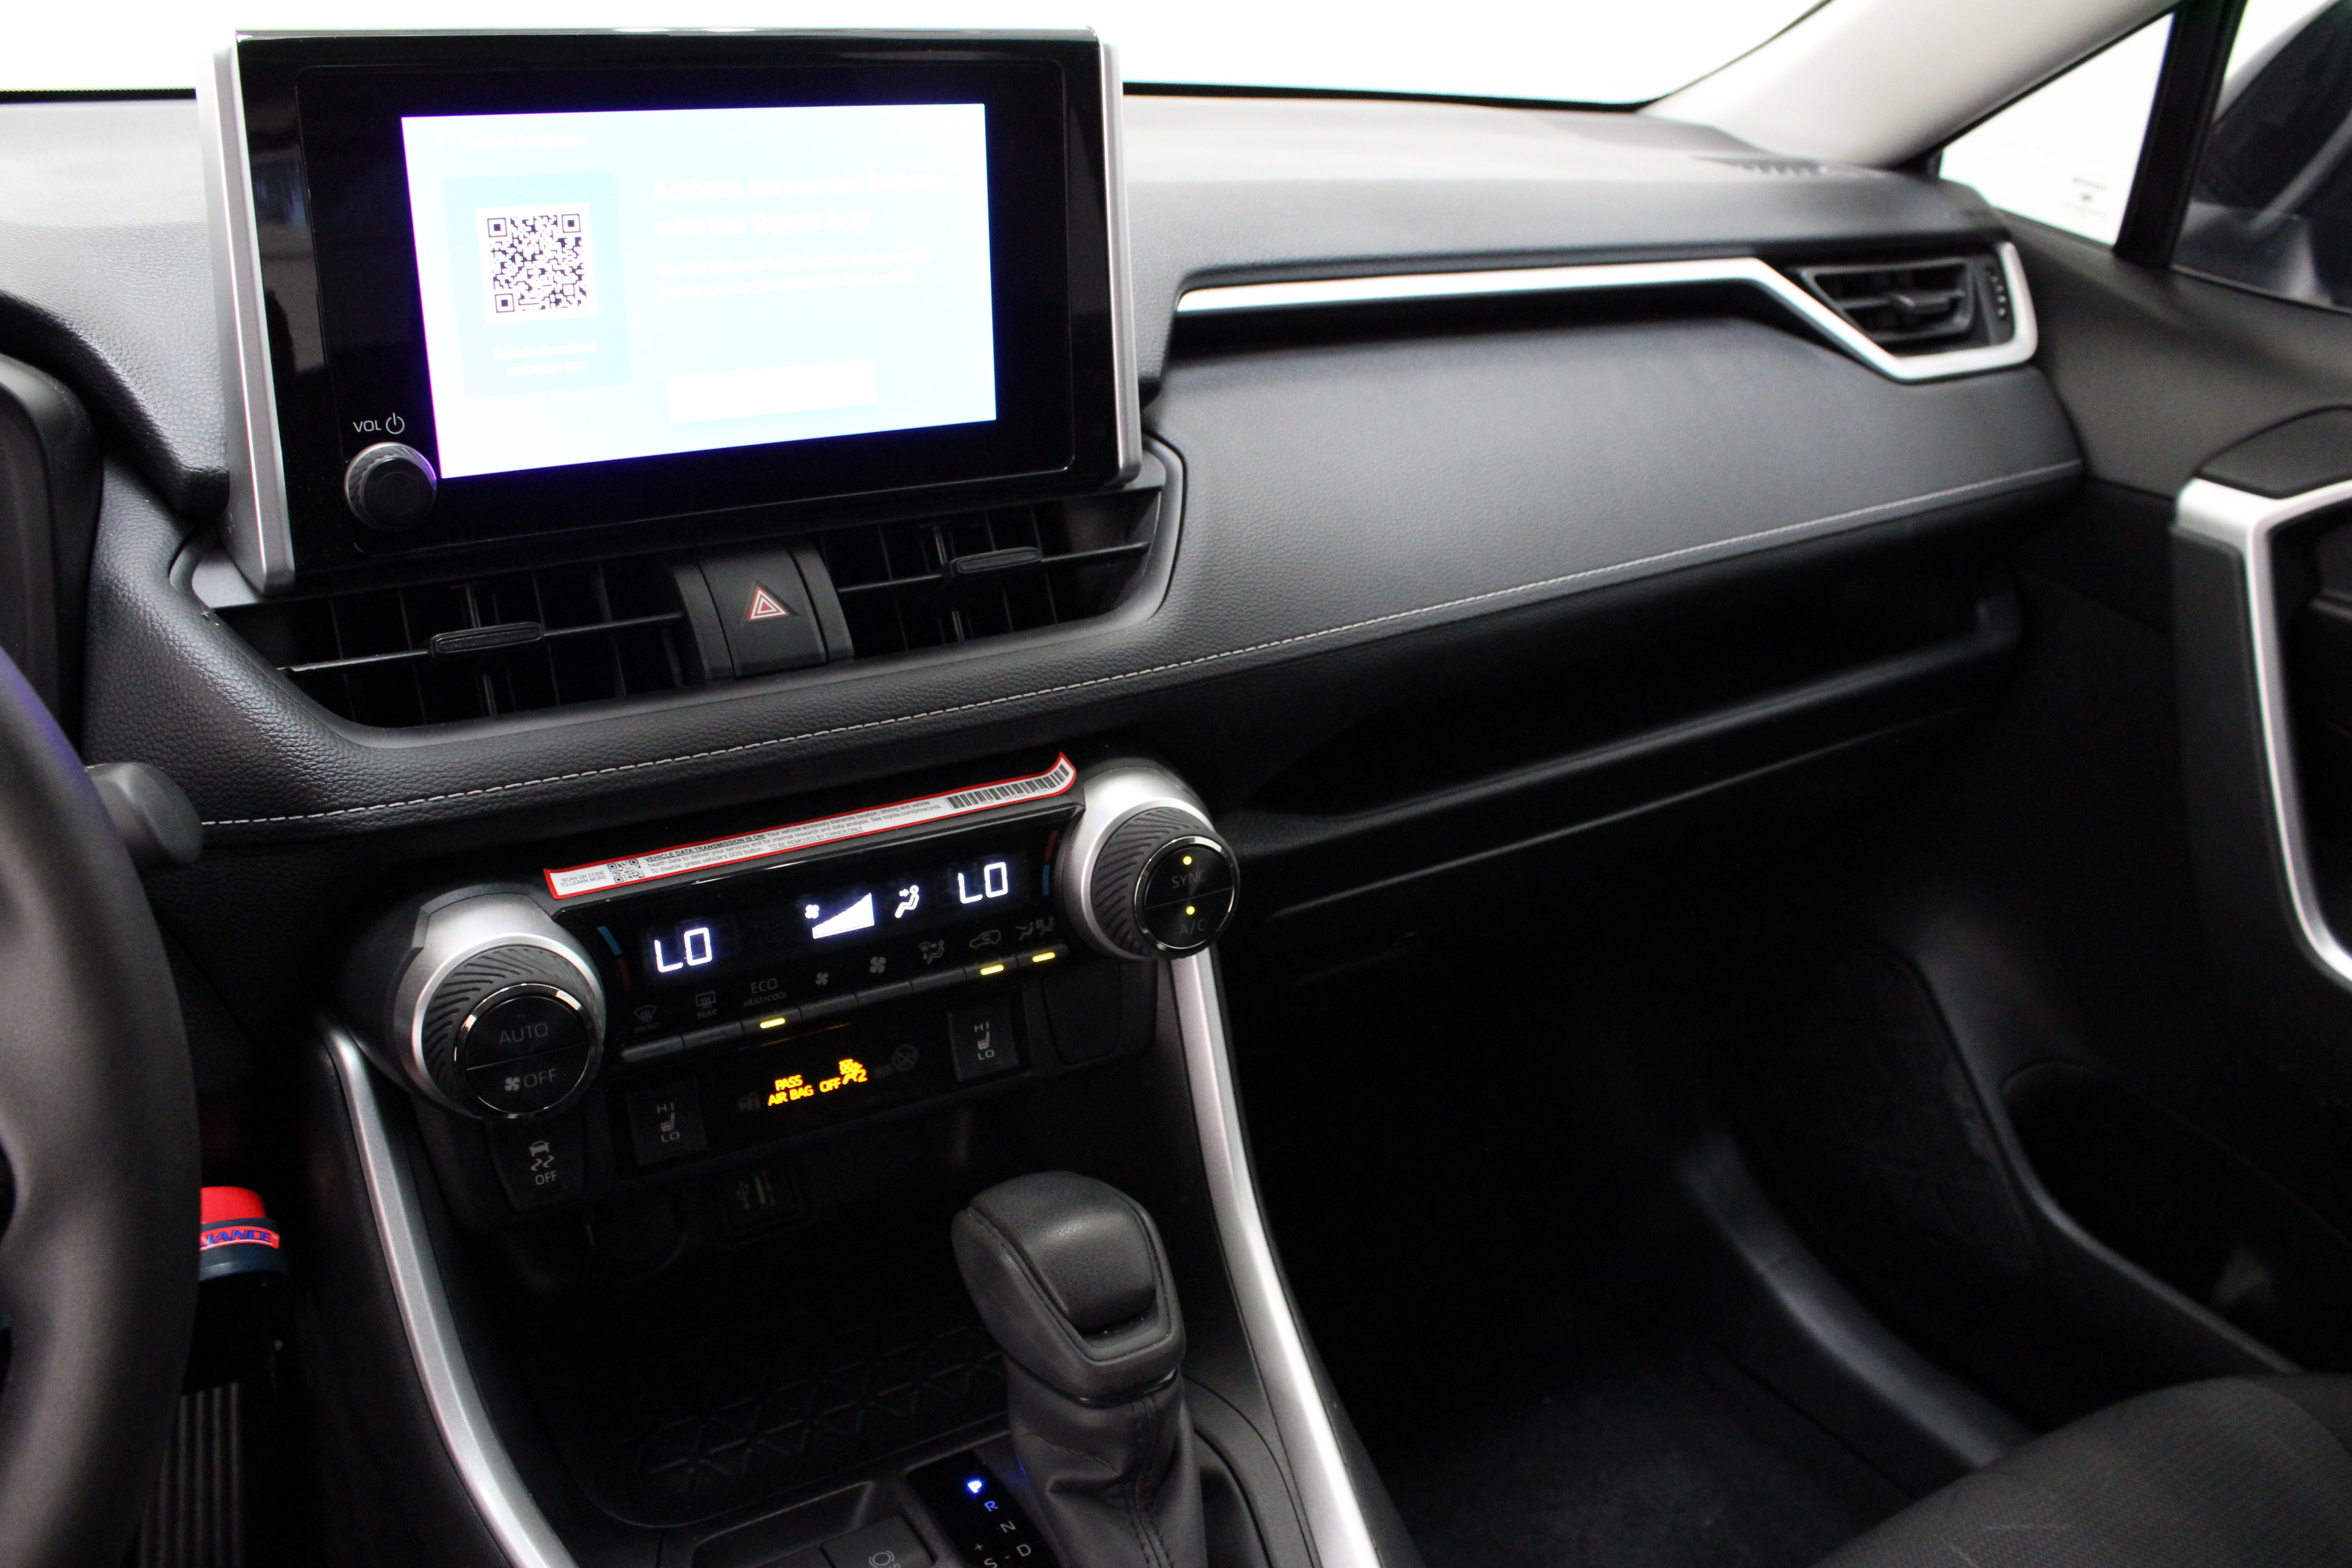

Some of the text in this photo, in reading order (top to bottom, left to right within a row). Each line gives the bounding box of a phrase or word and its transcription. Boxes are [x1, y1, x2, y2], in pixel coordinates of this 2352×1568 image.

[353, 420, 382, 432] VOL
[644, 852, 674, 862] VEHICLE
[694, 837, 744, 852] TRANSMISSION
[802, 822, 830, 831] wirelessly
[702, 854, 728, 863] vehicle's
[787, 835, 816, 845] REMOVED
[726, 844, 750, 852] services
[773, 834, 793, 842] internal
[958, 862, 1008, 904] LO
[1172, 870, 1204, 888] SYNC
[1180, 919, 1205, 934] A/C
[654, 927, 712, 972] LO
[751, 978, 777, 993] ECO
[743, 991, 788, 1007] HEAT/COOL
[697, 1009, 717, 1019] REAR
[499, 1023, 548, 1045] AUTO
[635, 1022, 659, 1033] FRONT
[974, 1021, 989, 1032] HI
[978, 1049, 994, 1060] LO
[524, 1069, 557, 1087] OFF
[775, 1074, 803, 1091] PASS
[768, 1091, 788, 1106] AIR
[789, 1085, 814, 1100] BAG
[819, 1077, 841, 1092] OFF
[657, 1102, 675, 1113] HI
[661, 1131, 680, 1143] LO
[535, 1171, 557, 1185] OFF
[201, 1230, 272, 1247] IANCE
[968, 1480, 982, 1493] P
[984, 1500, 999, 1512] R
[1000, 1520, 1016, 1533] N
[1016, 1544, 1031, 1557] D
